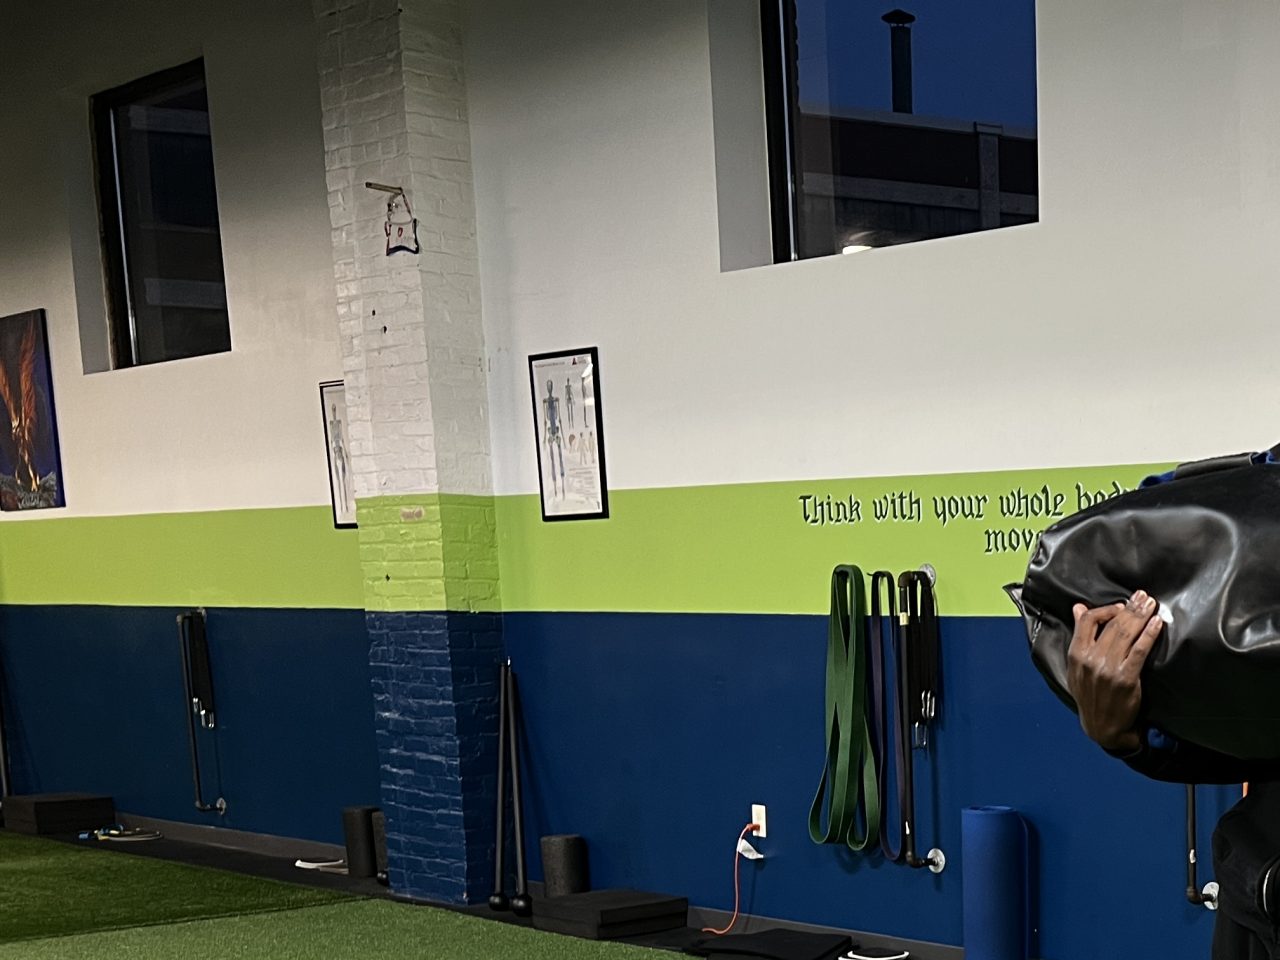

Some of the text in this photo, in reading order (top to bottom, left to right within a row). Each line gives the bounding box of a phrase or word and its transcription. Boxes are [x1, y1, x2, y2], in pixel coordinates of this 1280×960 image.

[798, 480, 1137, 527] Think with your whole bod
